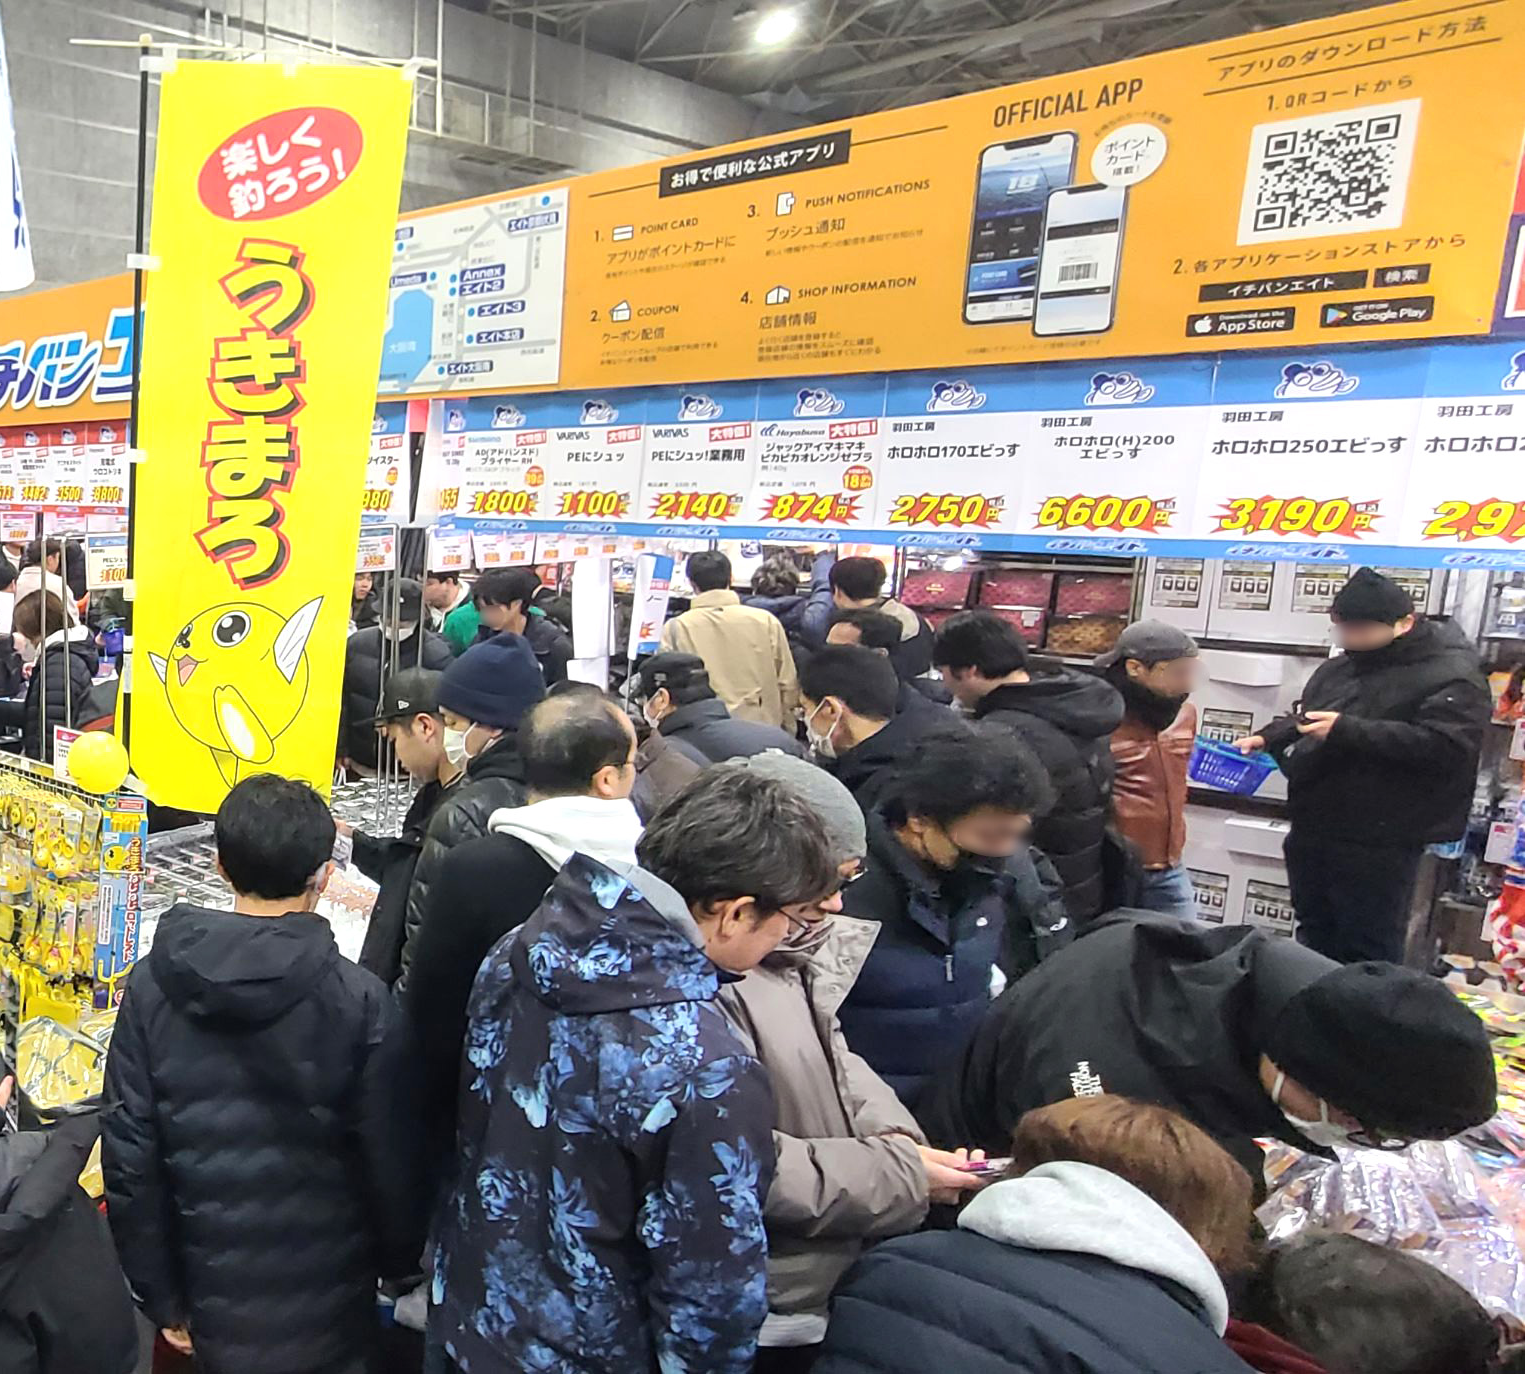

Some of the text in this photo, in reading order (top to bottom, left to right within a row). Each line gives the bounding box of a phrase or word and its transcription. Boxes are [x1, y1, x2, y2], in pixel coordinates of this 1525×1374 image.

[1218, 16, 1488, 82] アプリのダウンロード方法
[993, 89, 1088, 129] OFFICIAL
[1096, 78, 1144, 108] APP
[219, 115, 322, 181] 楽しく
[1105, 135, 1157, 154] ポイント
[670, 143, 836, 189] お得で便利な公式アプリ
[1106, 151, 1145, 166] カード
[227, 147, 347, 219] 釣ろう!
[805, 196, 834, 210] PUSH
[837, 179, 931, 205] NOTIFICATIONS
[640, 221, 668, 235] POINT
[670, 217, 699, 231] CARD
[766, 217, 846, 242] プッシュ通知
[607, 235, 737, 266] アプリがポイントカードに
[460, 281, 502, 295] エイト2
[797, 286, 829, 300] SHOP
[832, 276, 917, 297] INFORMATION
[1228, 277, 1336, 297] イチバンエイト
[480, 302, 524, 316] エイト3
[637, 304, 680, 318] COUPON
[1352, 307, 1427, 323] Google Play
[759, 311, 817, 330] 店舗情報
[1217, 317, 1286, 334] App Store
[601, 327, 665, 344] クーポン配信
[193, 238, 317, 591] うきまろ
[1222, 410, 1284, 423] 羽田工房
[1437, 404, 1514, 418] 羽田工房
[892, 422, 936, 433] 羽田工房
[1041, 416, 1093, 428] 羽田工房
[557, 431, 590, 441] VARIVAS
[652, 428, 689, 438] VARIVAS
[1054, 434, 1175, 448] ホロホロ(H)200
[766, 441, 865, 453] ジャックアイマキマキ
[887, 443, 1021, 460] ホロホロ170エビっす
[1079, 447, 1143, 460] エビっす
[1211, 436, 1407, 455] ホロホロ250エビっす
[567, 451, 625, 462] PEにシュッ
[651, 449, 745, 462] PEにシュッ!業務用
